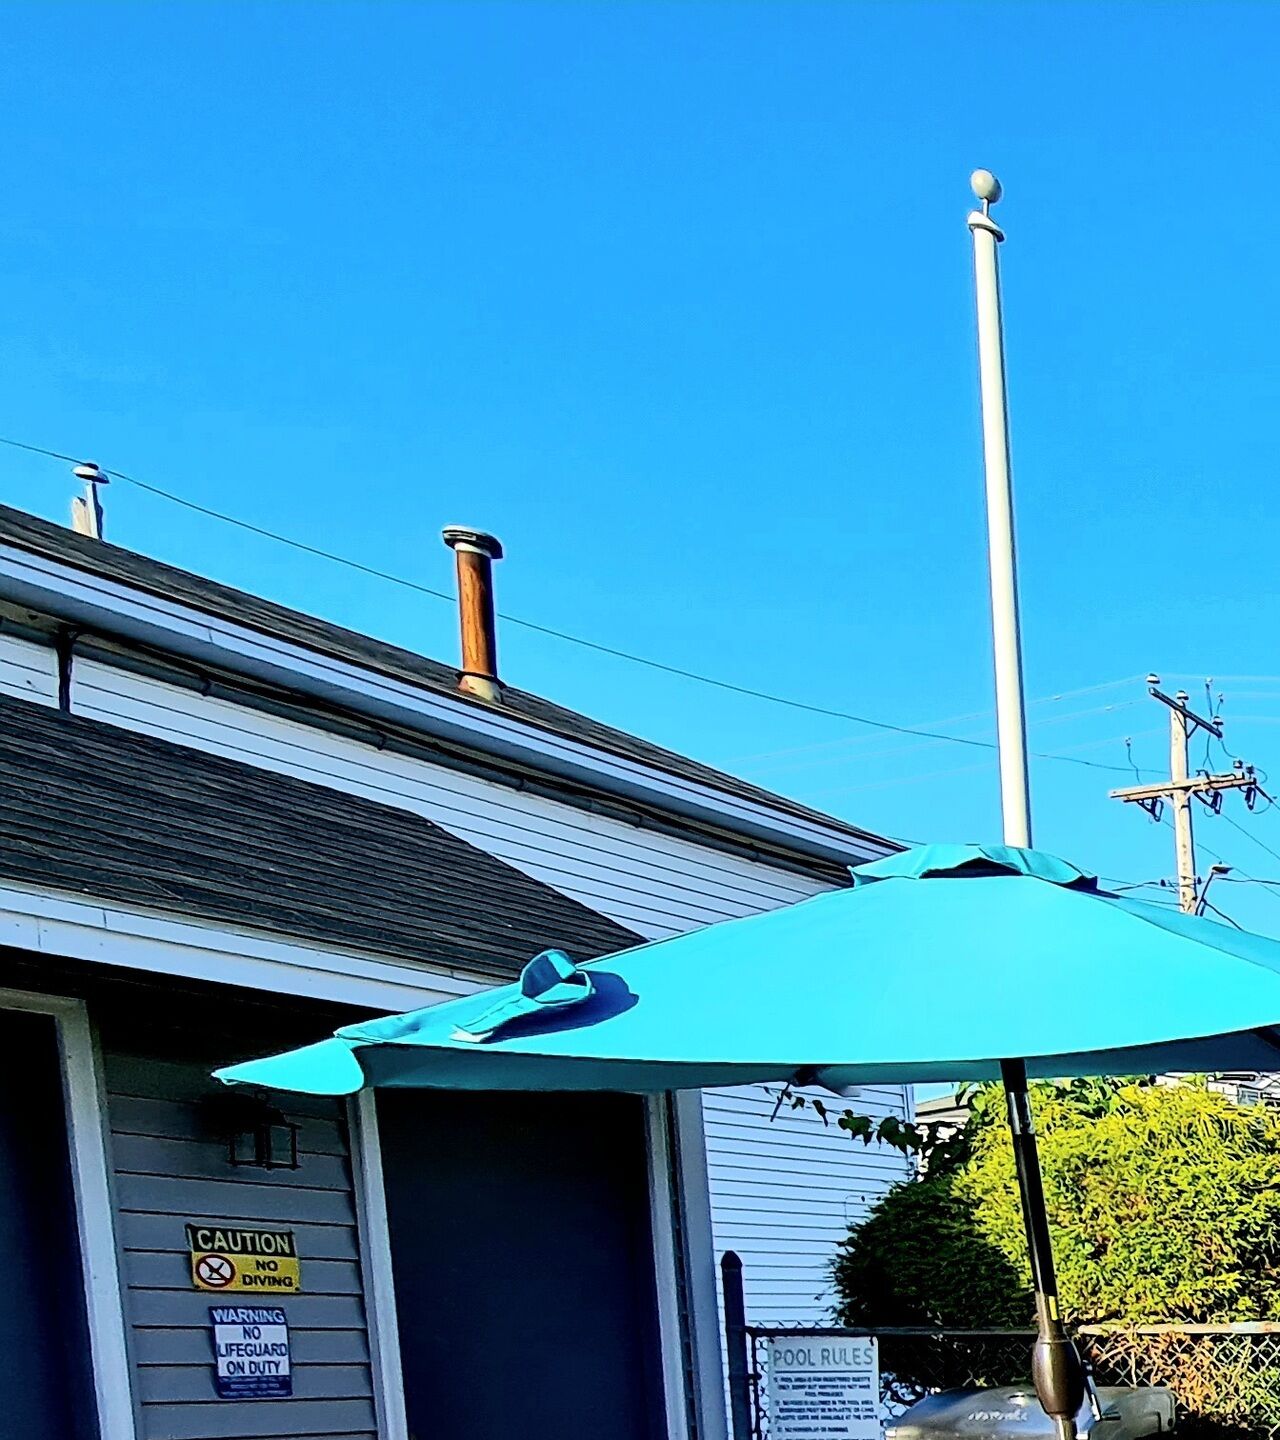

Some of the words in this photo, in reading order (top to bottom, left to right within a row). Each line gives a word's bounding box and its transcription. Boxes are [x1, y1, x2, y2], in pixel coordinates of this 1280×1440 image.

[197, 1229, 291, 1254] CAUTION
[255, 1260, 278, 1272] NO
[242, 1276, 293, 1287] DIVING
[212, 1309, 285, 1323] WARNING
[243, 1326, 260, 1340] NO
[218, 1343, 287, 1357] LIFEGUARD
[773, 1348, 816, 1366] POOL
[821, 1348, 873, 1366] RULES
[226, 1361, 245, 1375] ON
[249, 1360, 281, 1375] DUTY
